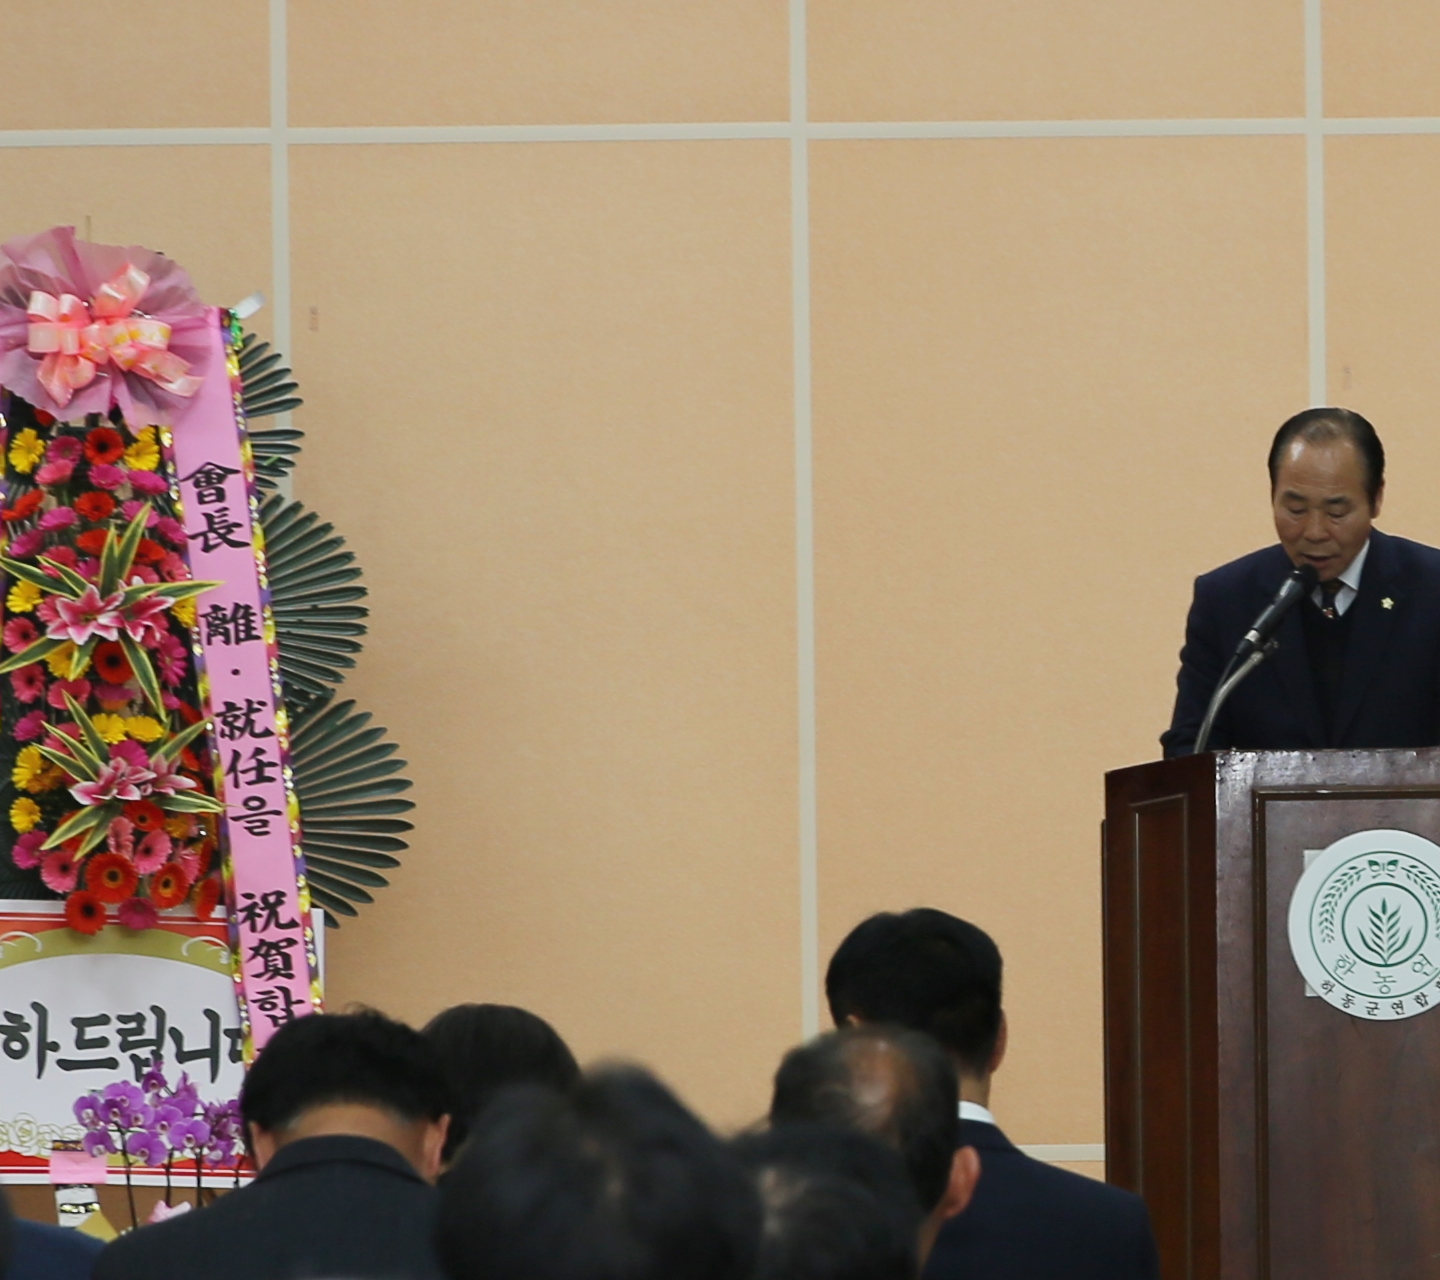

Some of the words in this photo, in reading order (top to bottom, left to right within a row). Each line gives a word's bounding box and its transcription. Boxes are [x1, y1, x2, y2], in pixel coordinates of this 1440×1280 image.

[178, 461, 251, 554] 會長
[236, 889, 307, 1052] 祝賀합
[1333, 952, 1439, 995] 한농연
